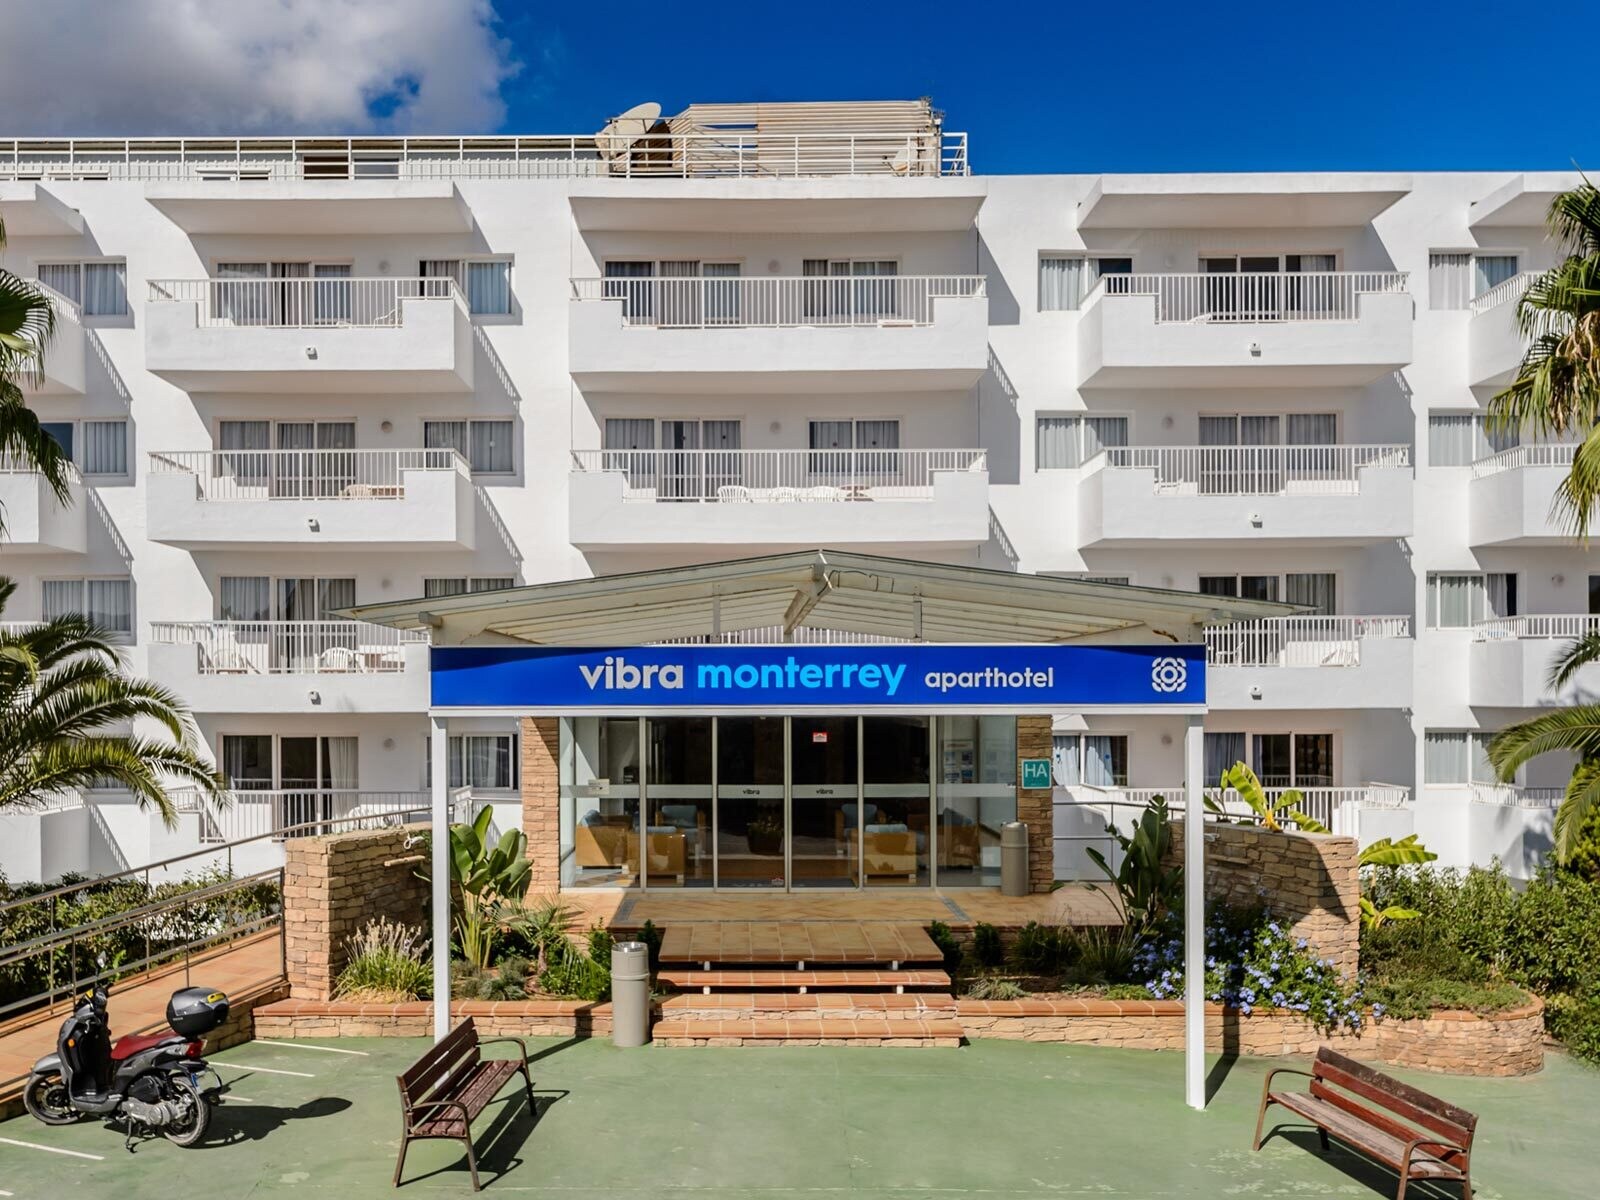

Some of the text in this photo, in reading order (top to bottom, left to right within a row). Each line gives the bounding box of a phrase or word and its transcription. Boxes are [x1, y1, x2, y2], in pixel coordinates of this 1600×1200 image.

[578, 656, 1054, 696] vibra monterrey aparthotel
[1024, 763, 1048, 778] HA
